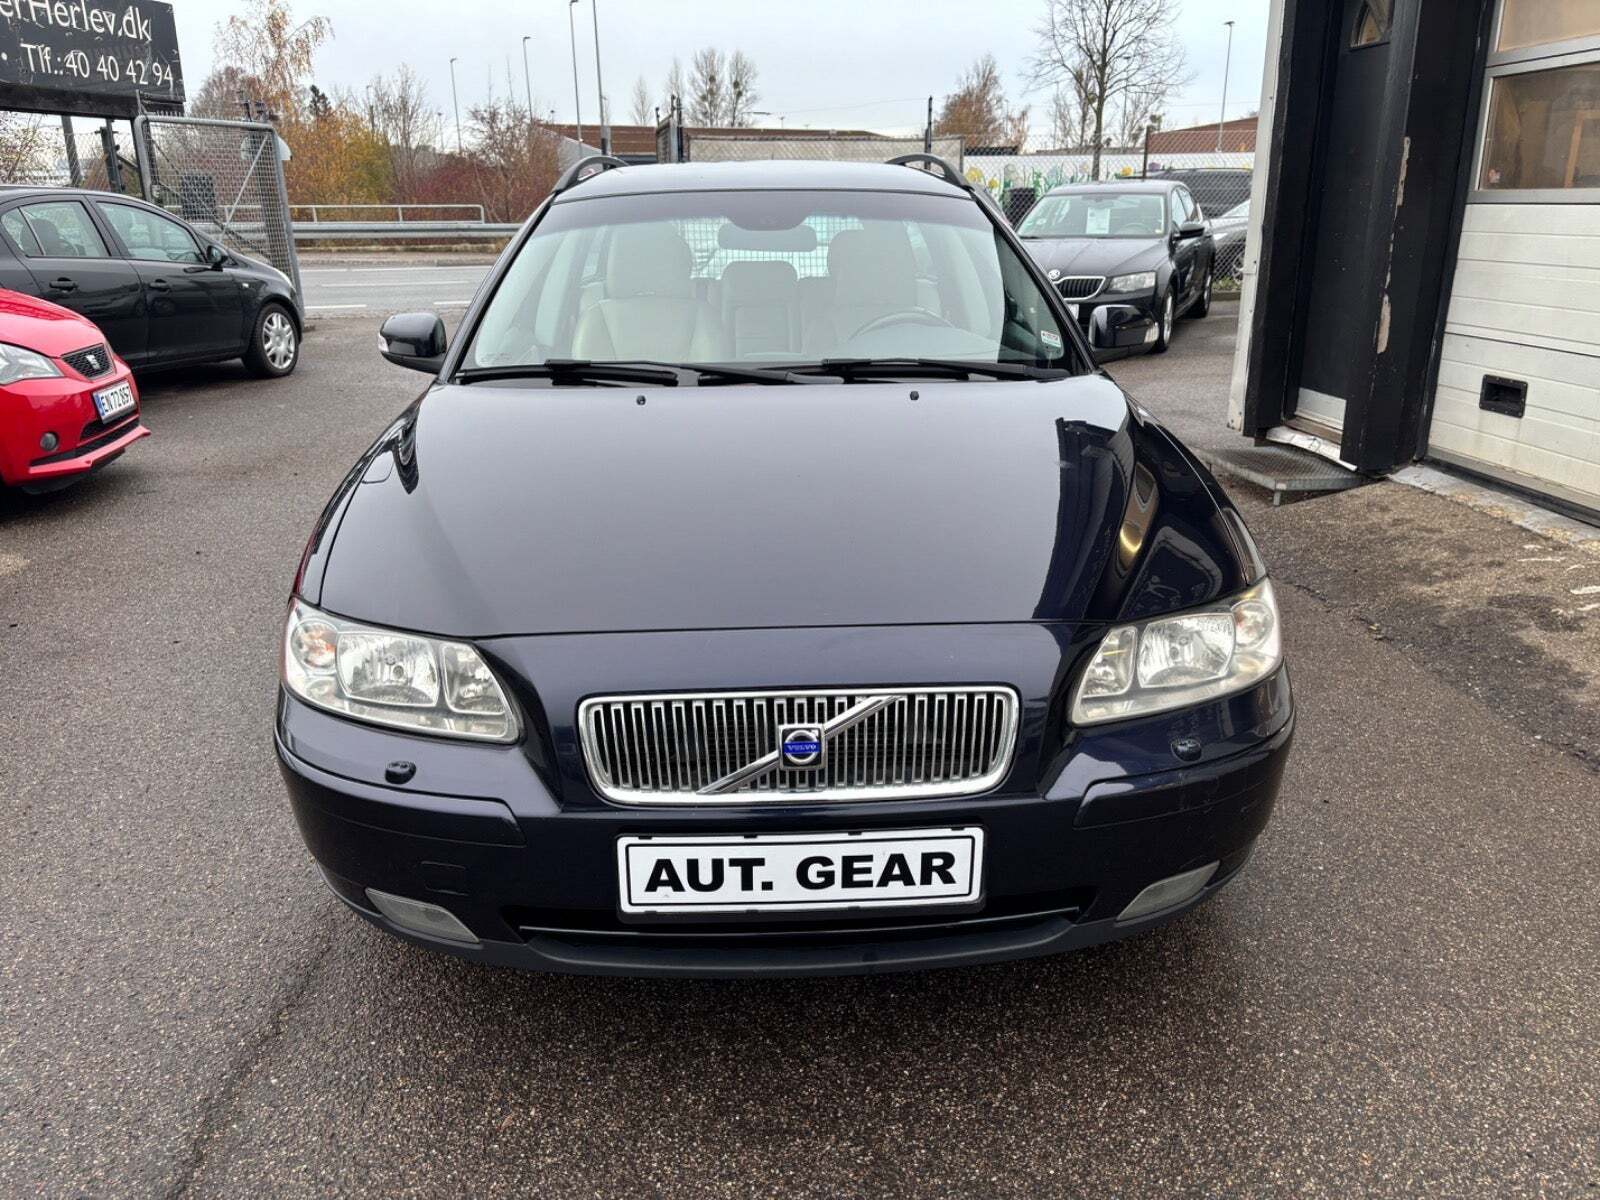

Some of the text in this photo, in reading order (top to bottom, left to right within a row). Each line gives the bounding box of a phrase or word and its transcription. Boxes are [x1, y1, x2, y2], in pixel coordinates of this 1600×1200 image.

[97, 55, 120, 82] 40
[126, 59, 149, 85] 42
[152, 62, 174, 90] 94
[645, 851, 957, 892] AUT. GEAR
